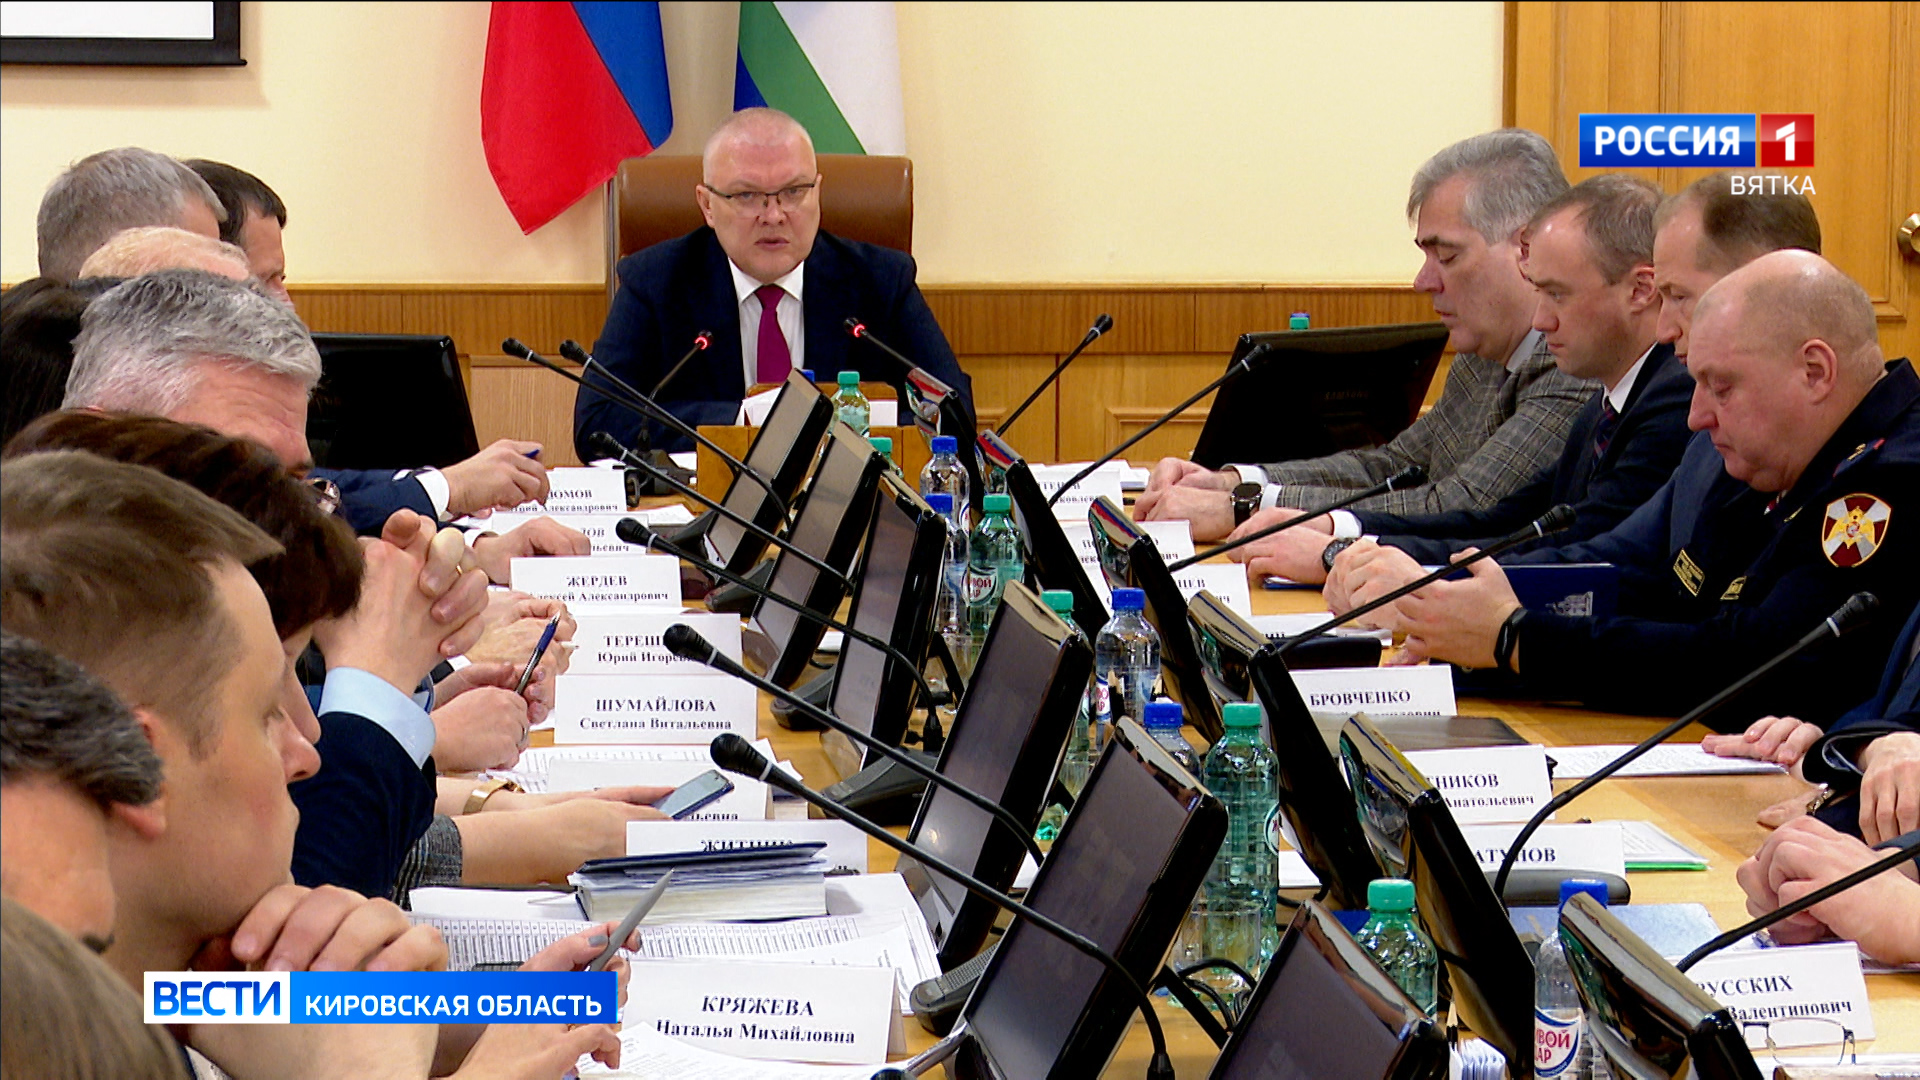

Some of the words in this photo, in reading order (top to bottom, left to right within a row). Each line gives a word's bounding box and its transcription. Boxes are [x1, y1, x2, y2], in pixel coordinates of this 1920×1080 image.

[566, 575, 628, 588] ЖЕРДЕВ
[578, 592, 669, 602] Александрович
[598, 652, 637, 665] Юрий
[596, 696, 717, 712] ШУМАЙЛОВА
[1310, 690, 1411, 706] БРОВЧЕНКО
[579, 717, 646, 730] Светлана
[650, 717, 732, 730] Витальевна
[701, 995, 815, 1017] КРЯЖЕВА
[656, 1020, 733, 1039] Наталья
[739, 1022, 856, 1044] Михайловна
